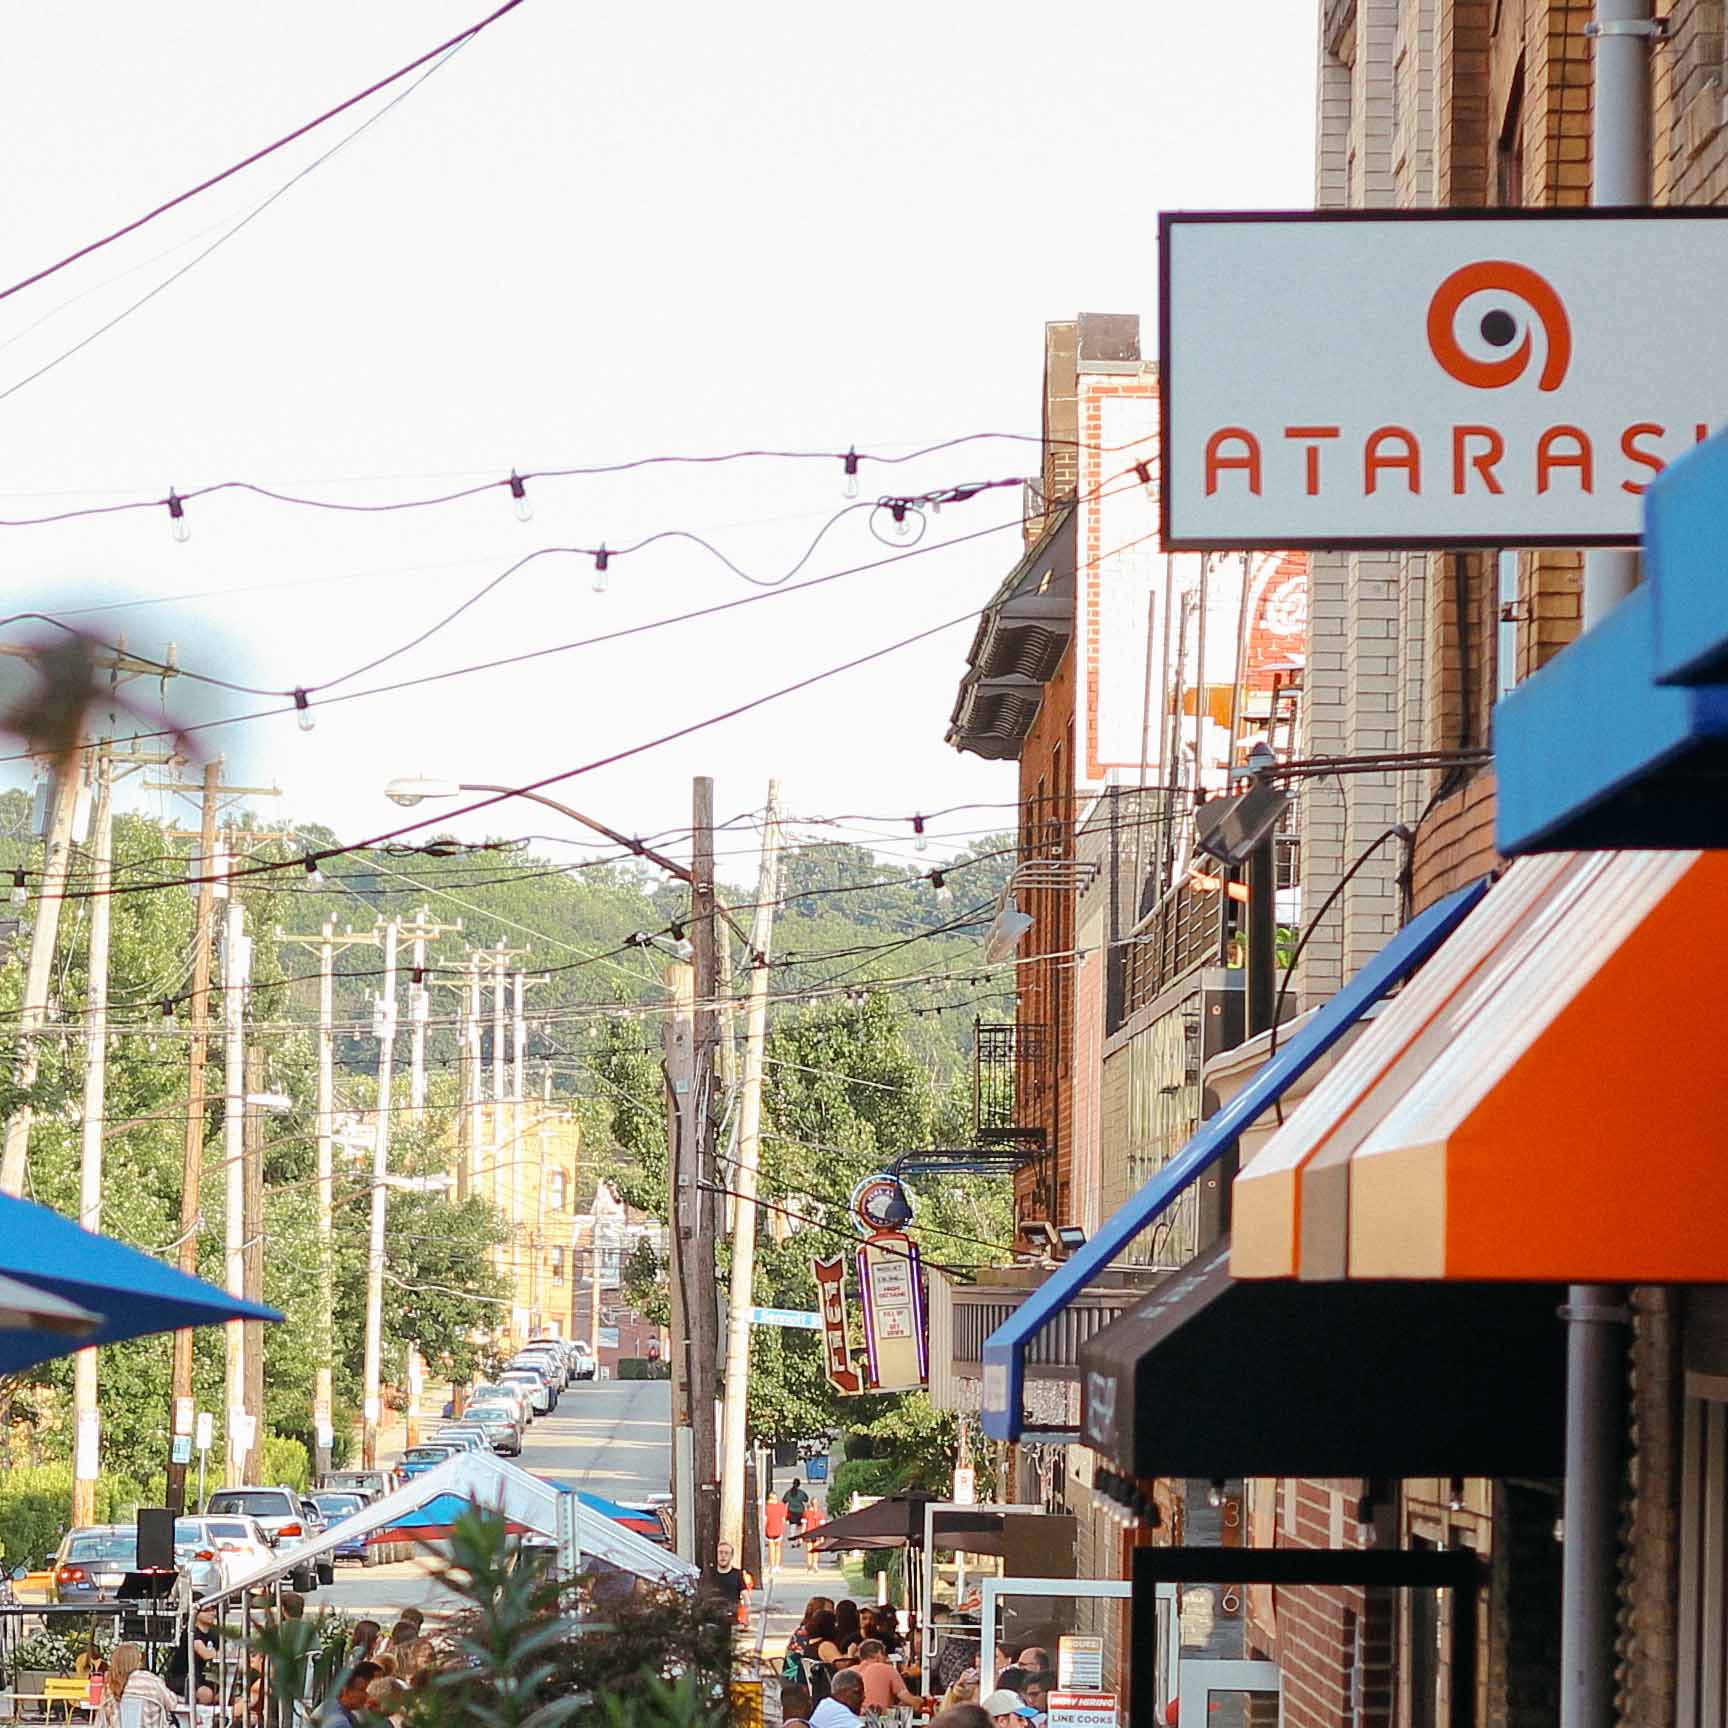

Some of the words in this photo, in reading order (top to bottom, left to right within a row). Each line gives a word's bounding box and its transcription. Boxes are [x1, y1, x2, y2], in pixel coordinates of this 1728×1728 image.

[1205, 423, 1709, 497] ATARAS
[823, 1281, 847, 1372] FUEL
[1052, 1714, 1075, 1723] LINE
[1077, 1715, 1113, 1724] COOKS
